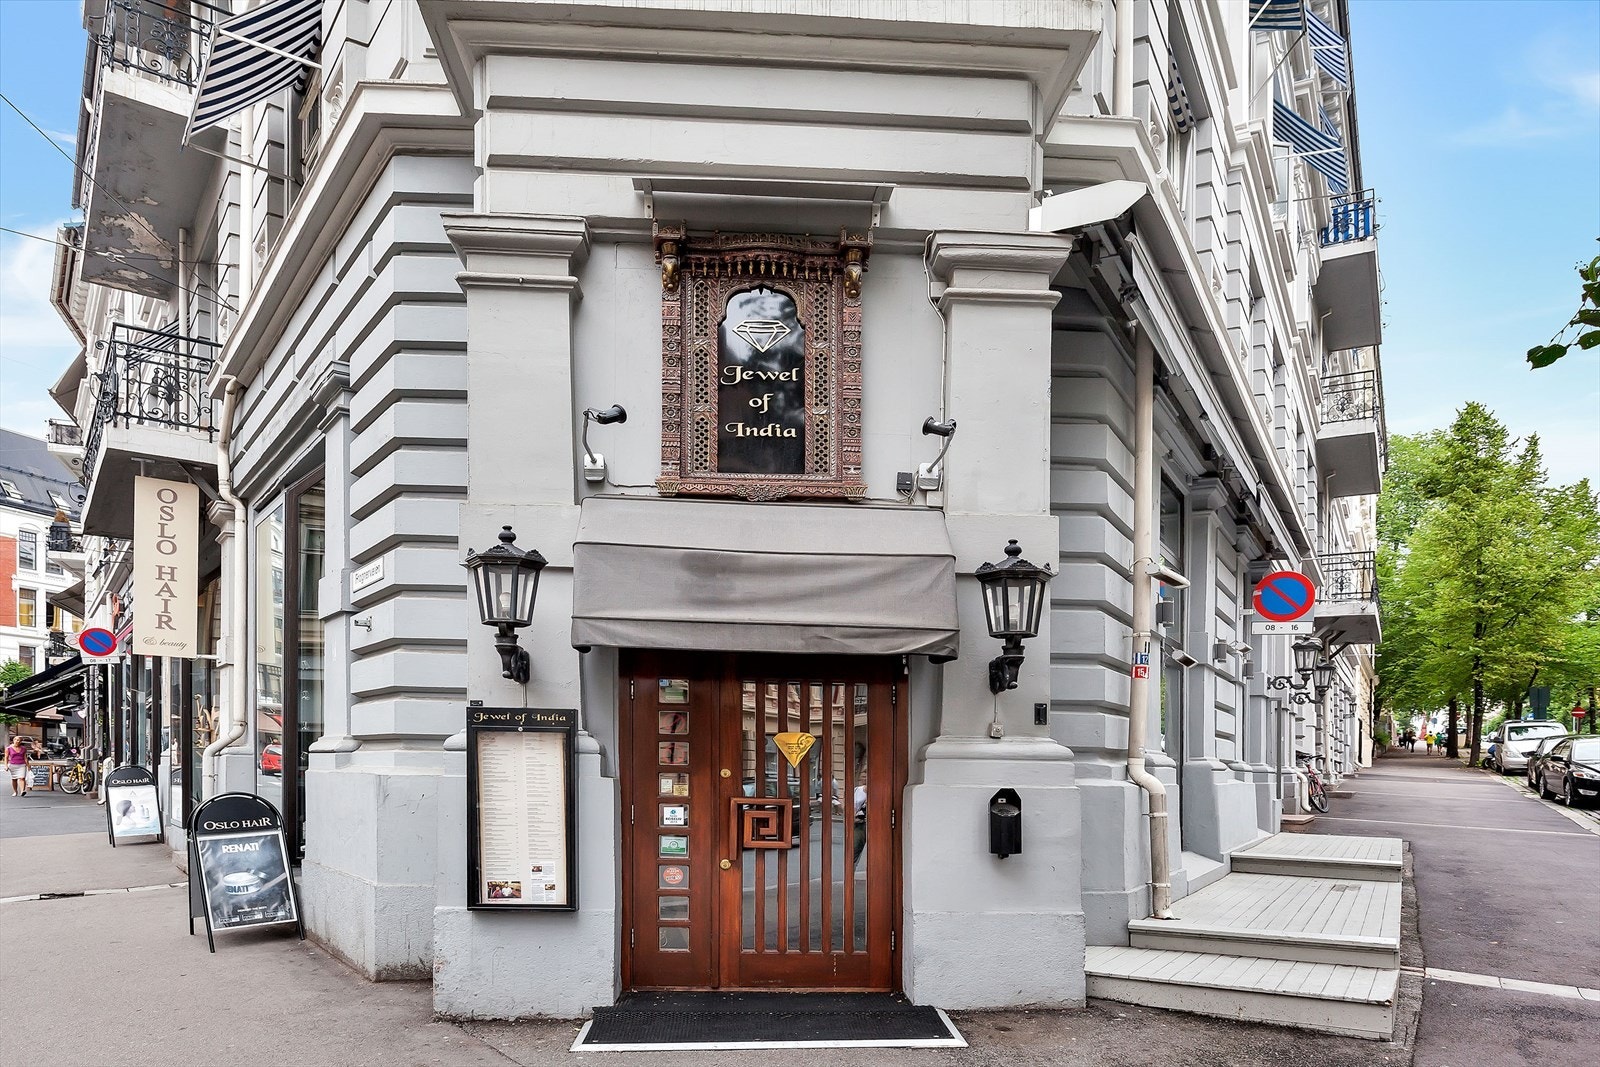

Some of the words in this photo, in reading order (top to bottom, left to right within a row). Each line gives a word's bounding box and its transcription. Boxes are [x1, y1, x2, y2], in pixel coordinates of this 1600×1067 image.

[720, 365, 800, 385] Jewel
[748, 393, 774, 414] of
[725, 422, 798, 438] India
[155, 488, 178, 556] OSLO
[155, 565, 178, 631] HAIR
[159, 638, 189, 651] beauty
[473, 712, 511, 723] Jewel
[514, 713, 528, 723] of
[531, 713, 566, 721] India
[203, 821, 240, 831] OSLO
[241, 817, 272, 828] HAIR
[221, 842, 260, 853] RENATI
